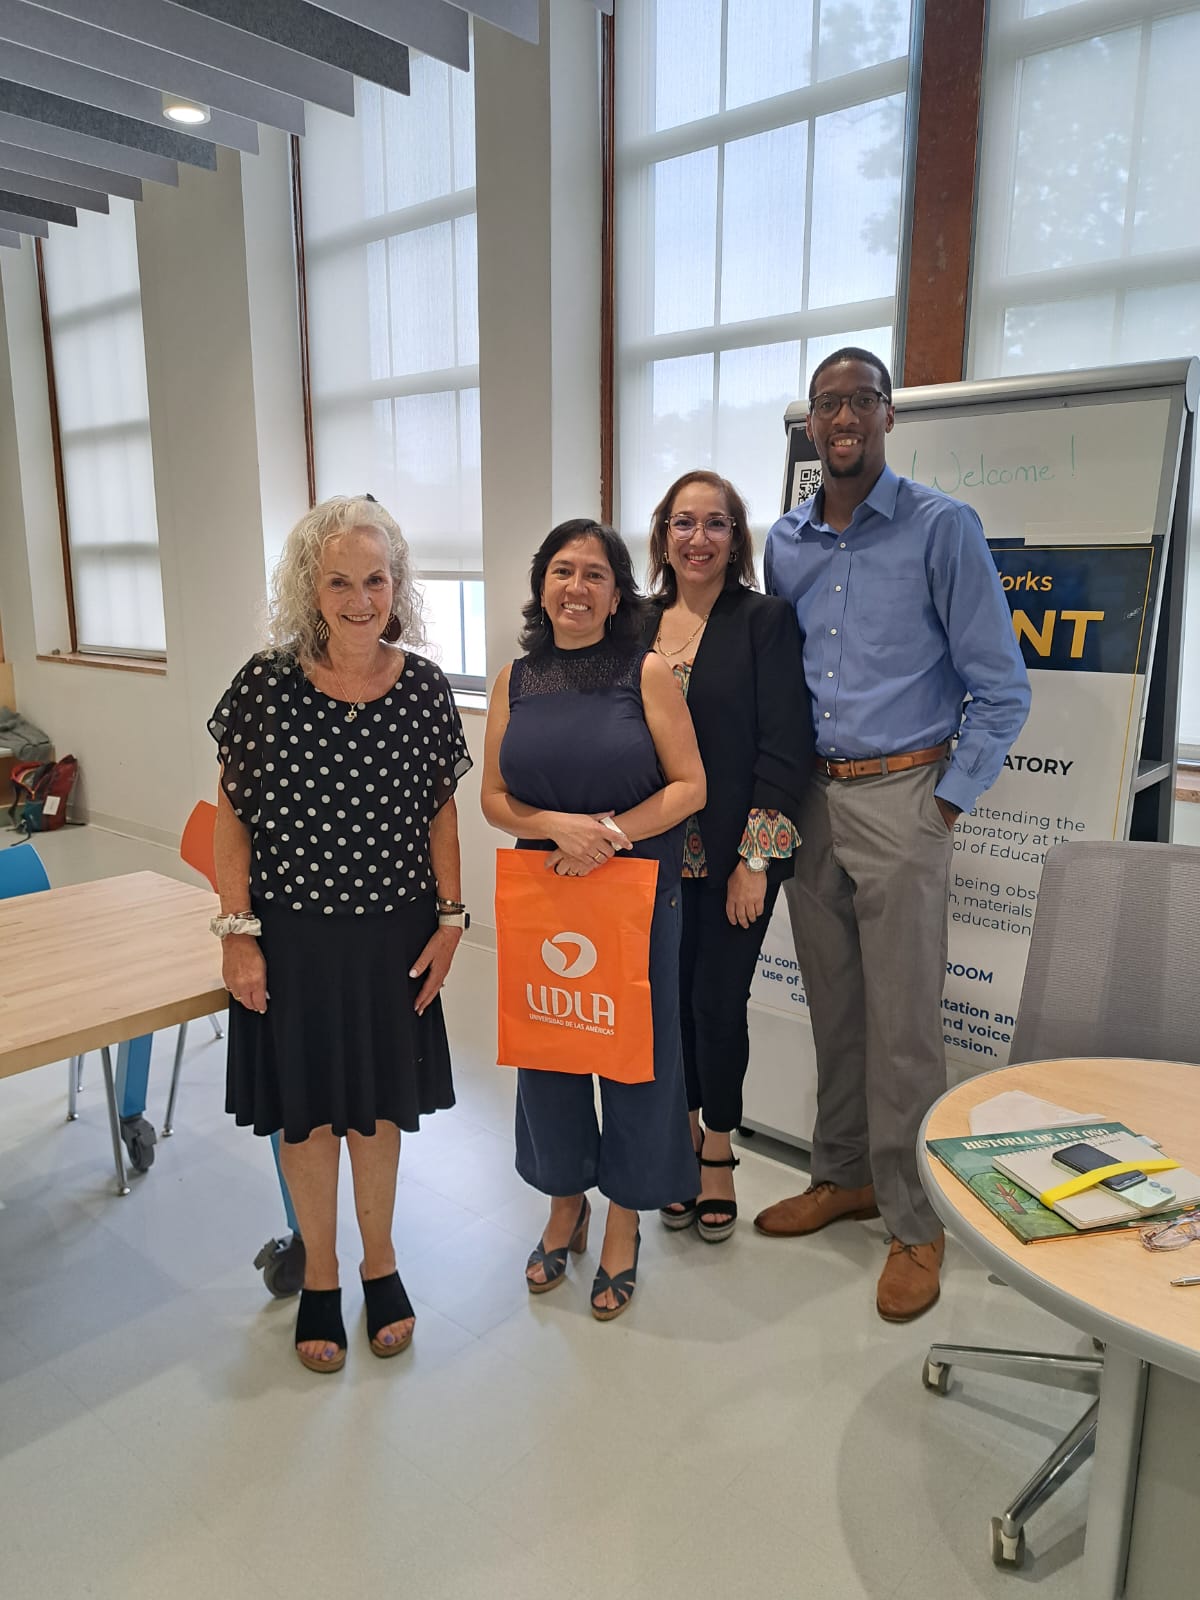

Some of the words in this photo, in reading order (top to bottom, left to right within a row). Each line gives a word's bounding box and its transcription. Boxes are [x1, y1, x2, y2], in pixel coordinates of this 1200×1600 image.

[997, 570, 1053, 591] orks
[1012, 609, 1105, 658] NT
[1003, 754, 1074, 776] ATORY
[969, 806, 1050, 830] attending
[1056, 817, 1086, 832] the
[953, 822, 1029, 846] aboratory
[1032, 835, 1049, 846] at
[970, 842, 986, 854] of
[990, 843, 1046, 864] Educat
[954, 873, 1000, 896] being
[1005, 884, 1039, 900] obs
[964, 896, 1033, 918] materials
[952, 912, 1031, 936] education
[757, 953, 771, 963] ou
[762, 969, 783, 982] use
[786, 975, 800, 986] of
[946, 961, 993, 984] ROOM
[526, 983, 615, 1026] UDLA
[791, 992, 809, 1006] ca
[574, 1022, 584, 1030] LAS
[943, 1017, 963, 1031] nd
[967, 1023, 1011, 1043] voice
[994, 1012, 1016, 1026] an
[943, 1034, 998, 1057] ession.
[962, 1136, 1033, 1150] HISTORIA
[1035, 1133, 1055, 1143] DE
